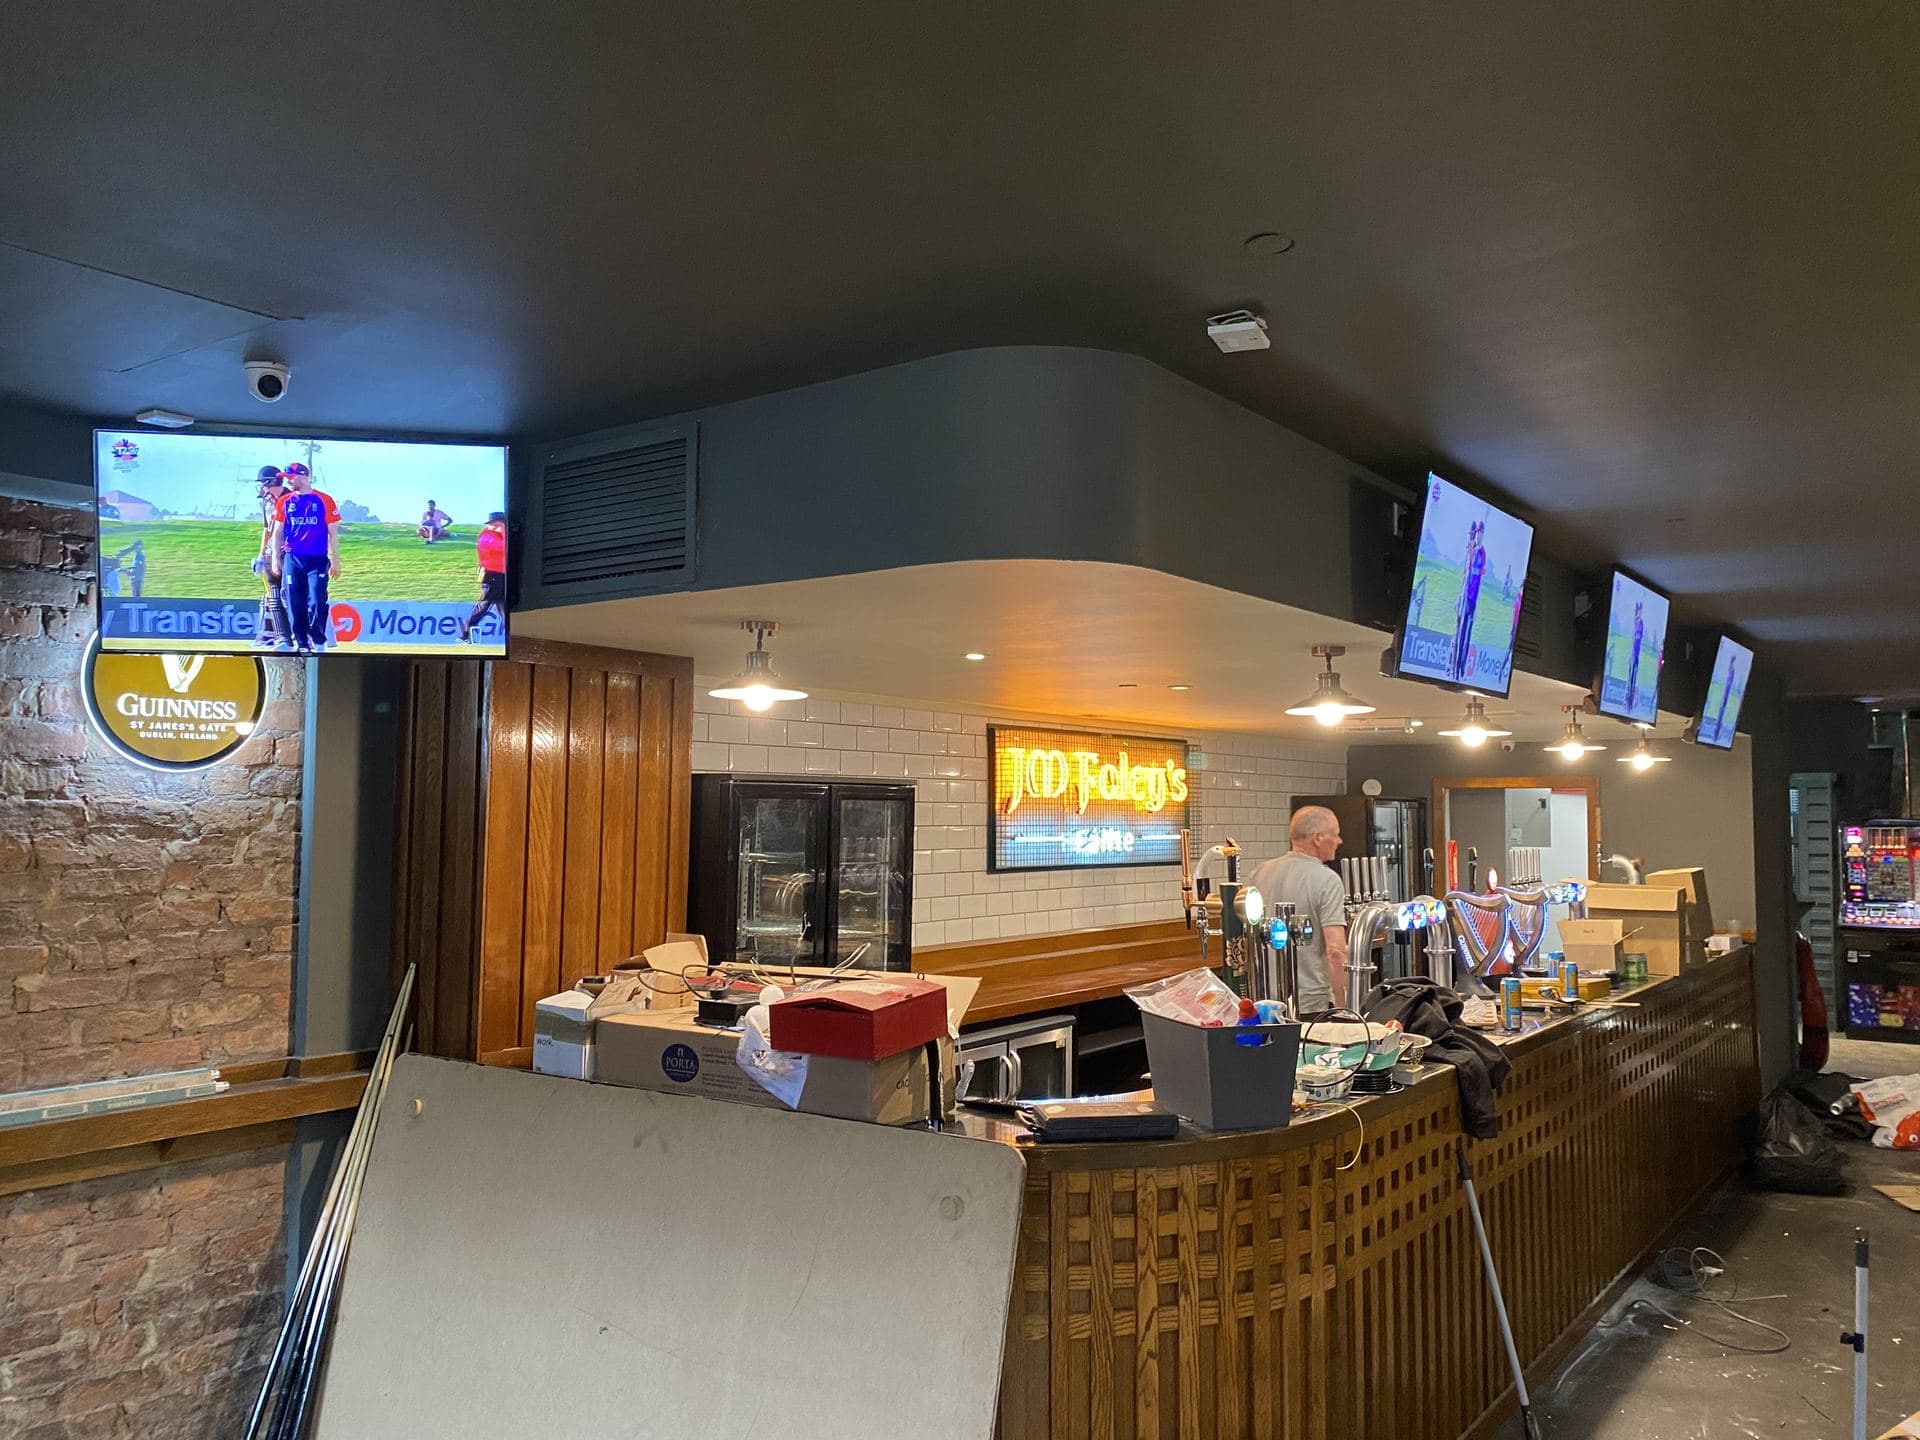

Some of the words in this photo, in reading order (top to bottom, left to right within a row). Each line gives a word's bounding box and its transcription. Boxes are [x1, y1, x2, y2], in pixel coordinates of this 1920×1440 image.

[120, 602, 261, 635] Transfe
[370, 608, 506, 637] MoneG
[1408, 630, 1452, 667] Transfe
[130, 721, 144, 730] ST
[665, 1056, 696, 1071] PORTA
